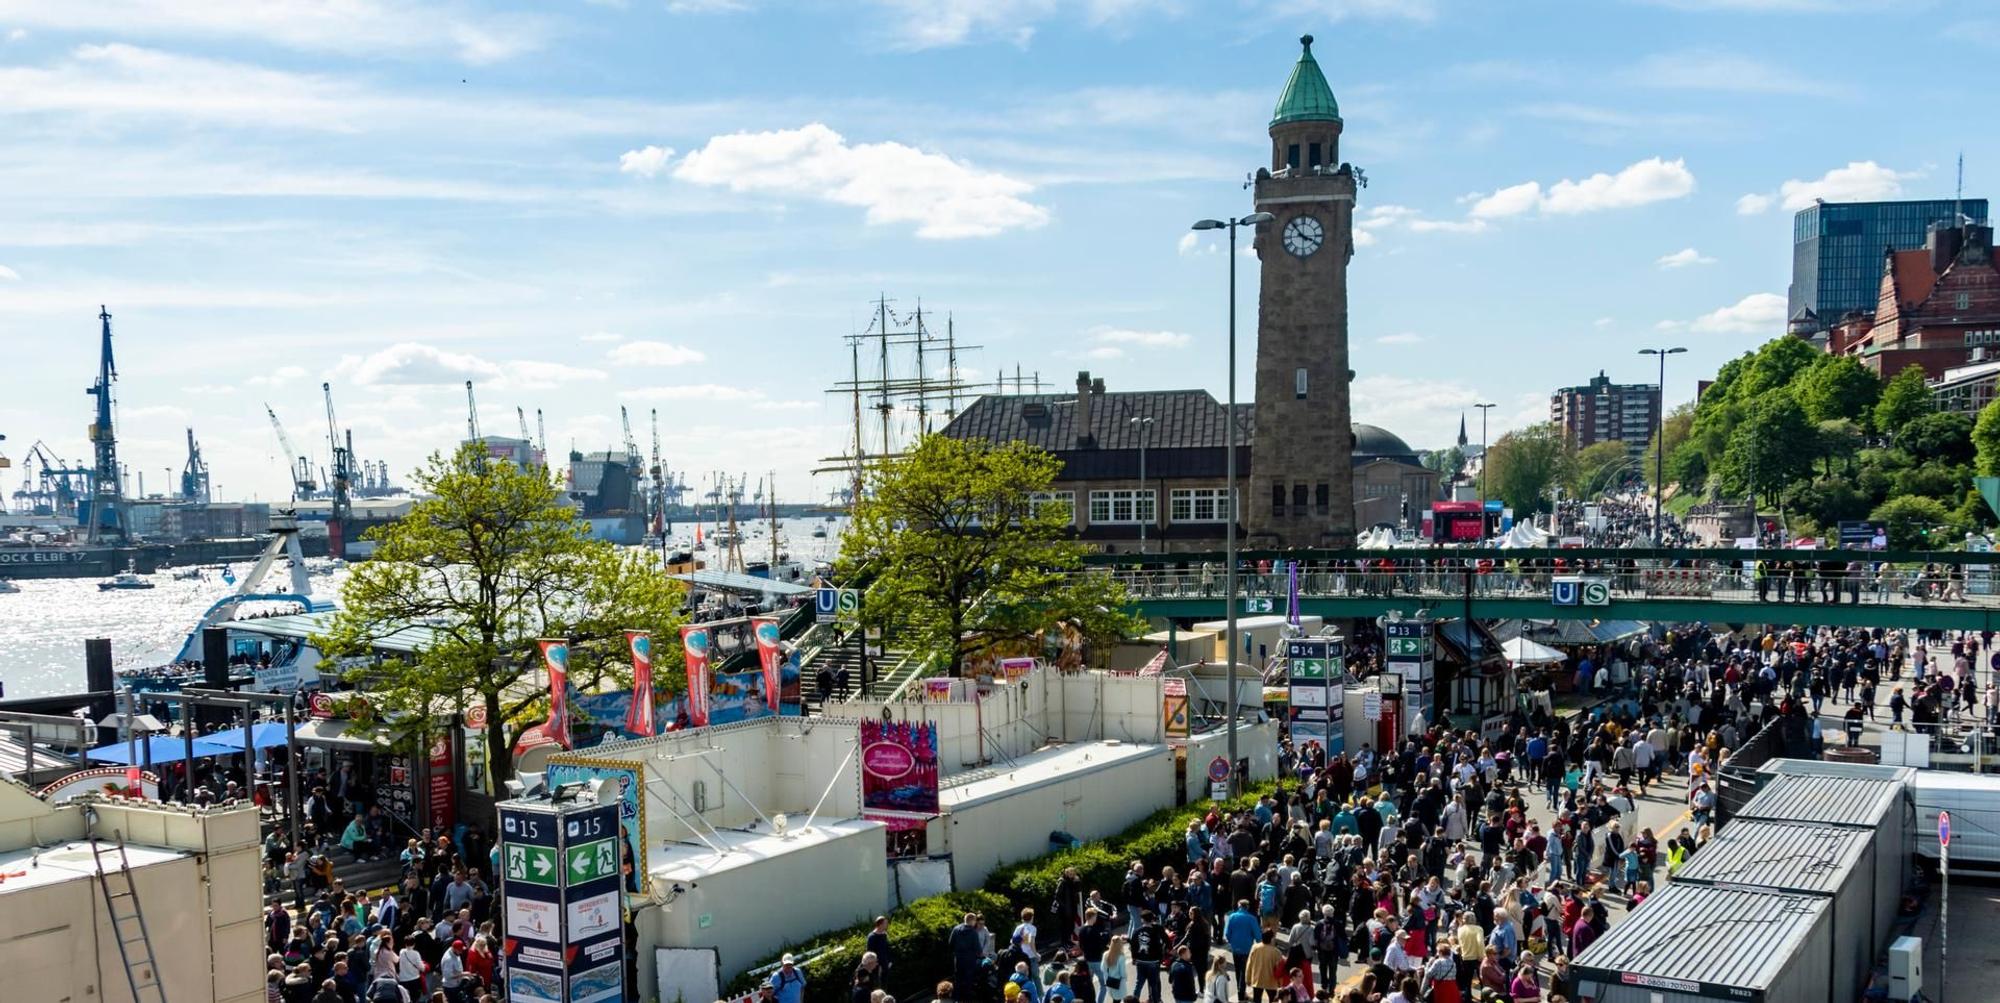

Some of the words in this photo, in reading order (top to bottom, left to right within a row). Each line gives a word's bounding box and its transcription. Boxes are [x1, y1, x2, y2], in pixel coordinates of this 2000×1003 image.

[0, 553, 28, 562] OCK
[34, 553, 68, 562] ELBE
[72, 552, 87, 561] 17
[819, 591, 833, 611] U
[840, 591, 856, 612] S
[1556, 583, 1574, 603] U
[1588, 584, 1606, 603] S
[1398, 626, 1410, 636] 13
[1301, 646, 1313, 656] 14
[520, 820, 538, 838] 15
[584, 817, 600, 836] 15
